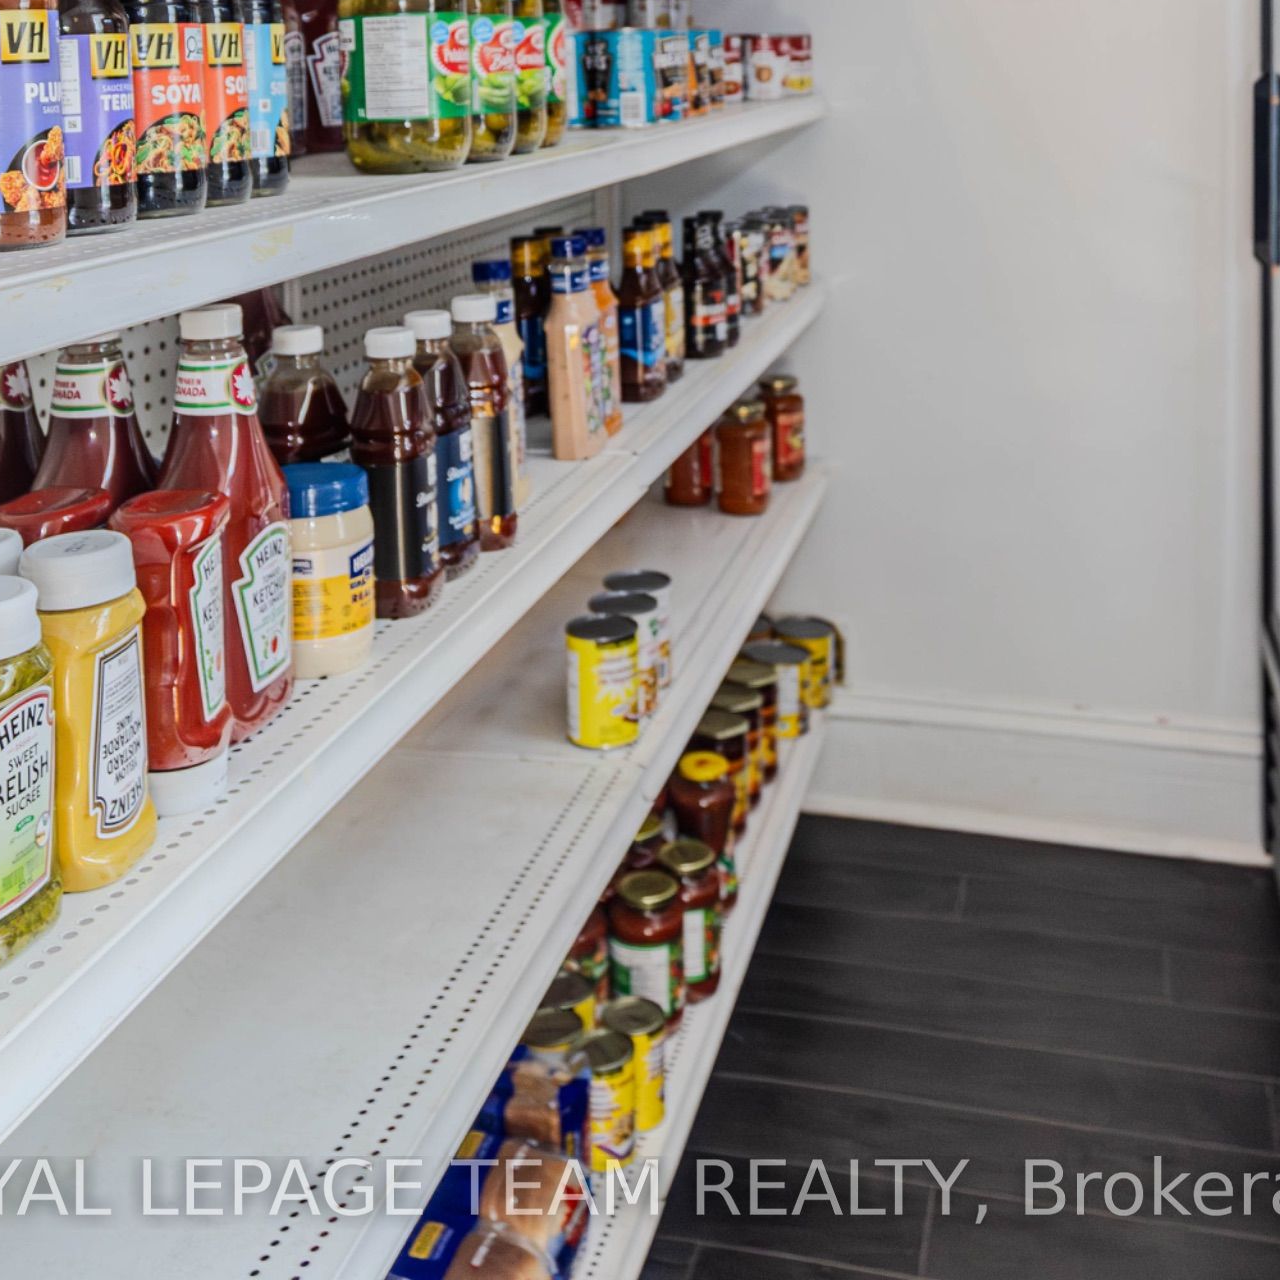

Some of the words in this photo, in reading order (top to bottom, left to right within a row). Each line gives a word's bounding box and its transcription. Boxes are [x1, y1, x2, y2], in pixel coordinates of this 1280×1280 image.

[5, 20, 46, 55] VH
[137, 32, 174, 62] VH
[212, 32, 239, 59] VH
[94, 40, 126, 71] VH
[151, 83, 202, 106] SOYA
[255, 538, 284, 569] HEINZ
[7, 741, 40, 773] SWEET
[109, 776, 144, 821] HEINZ
